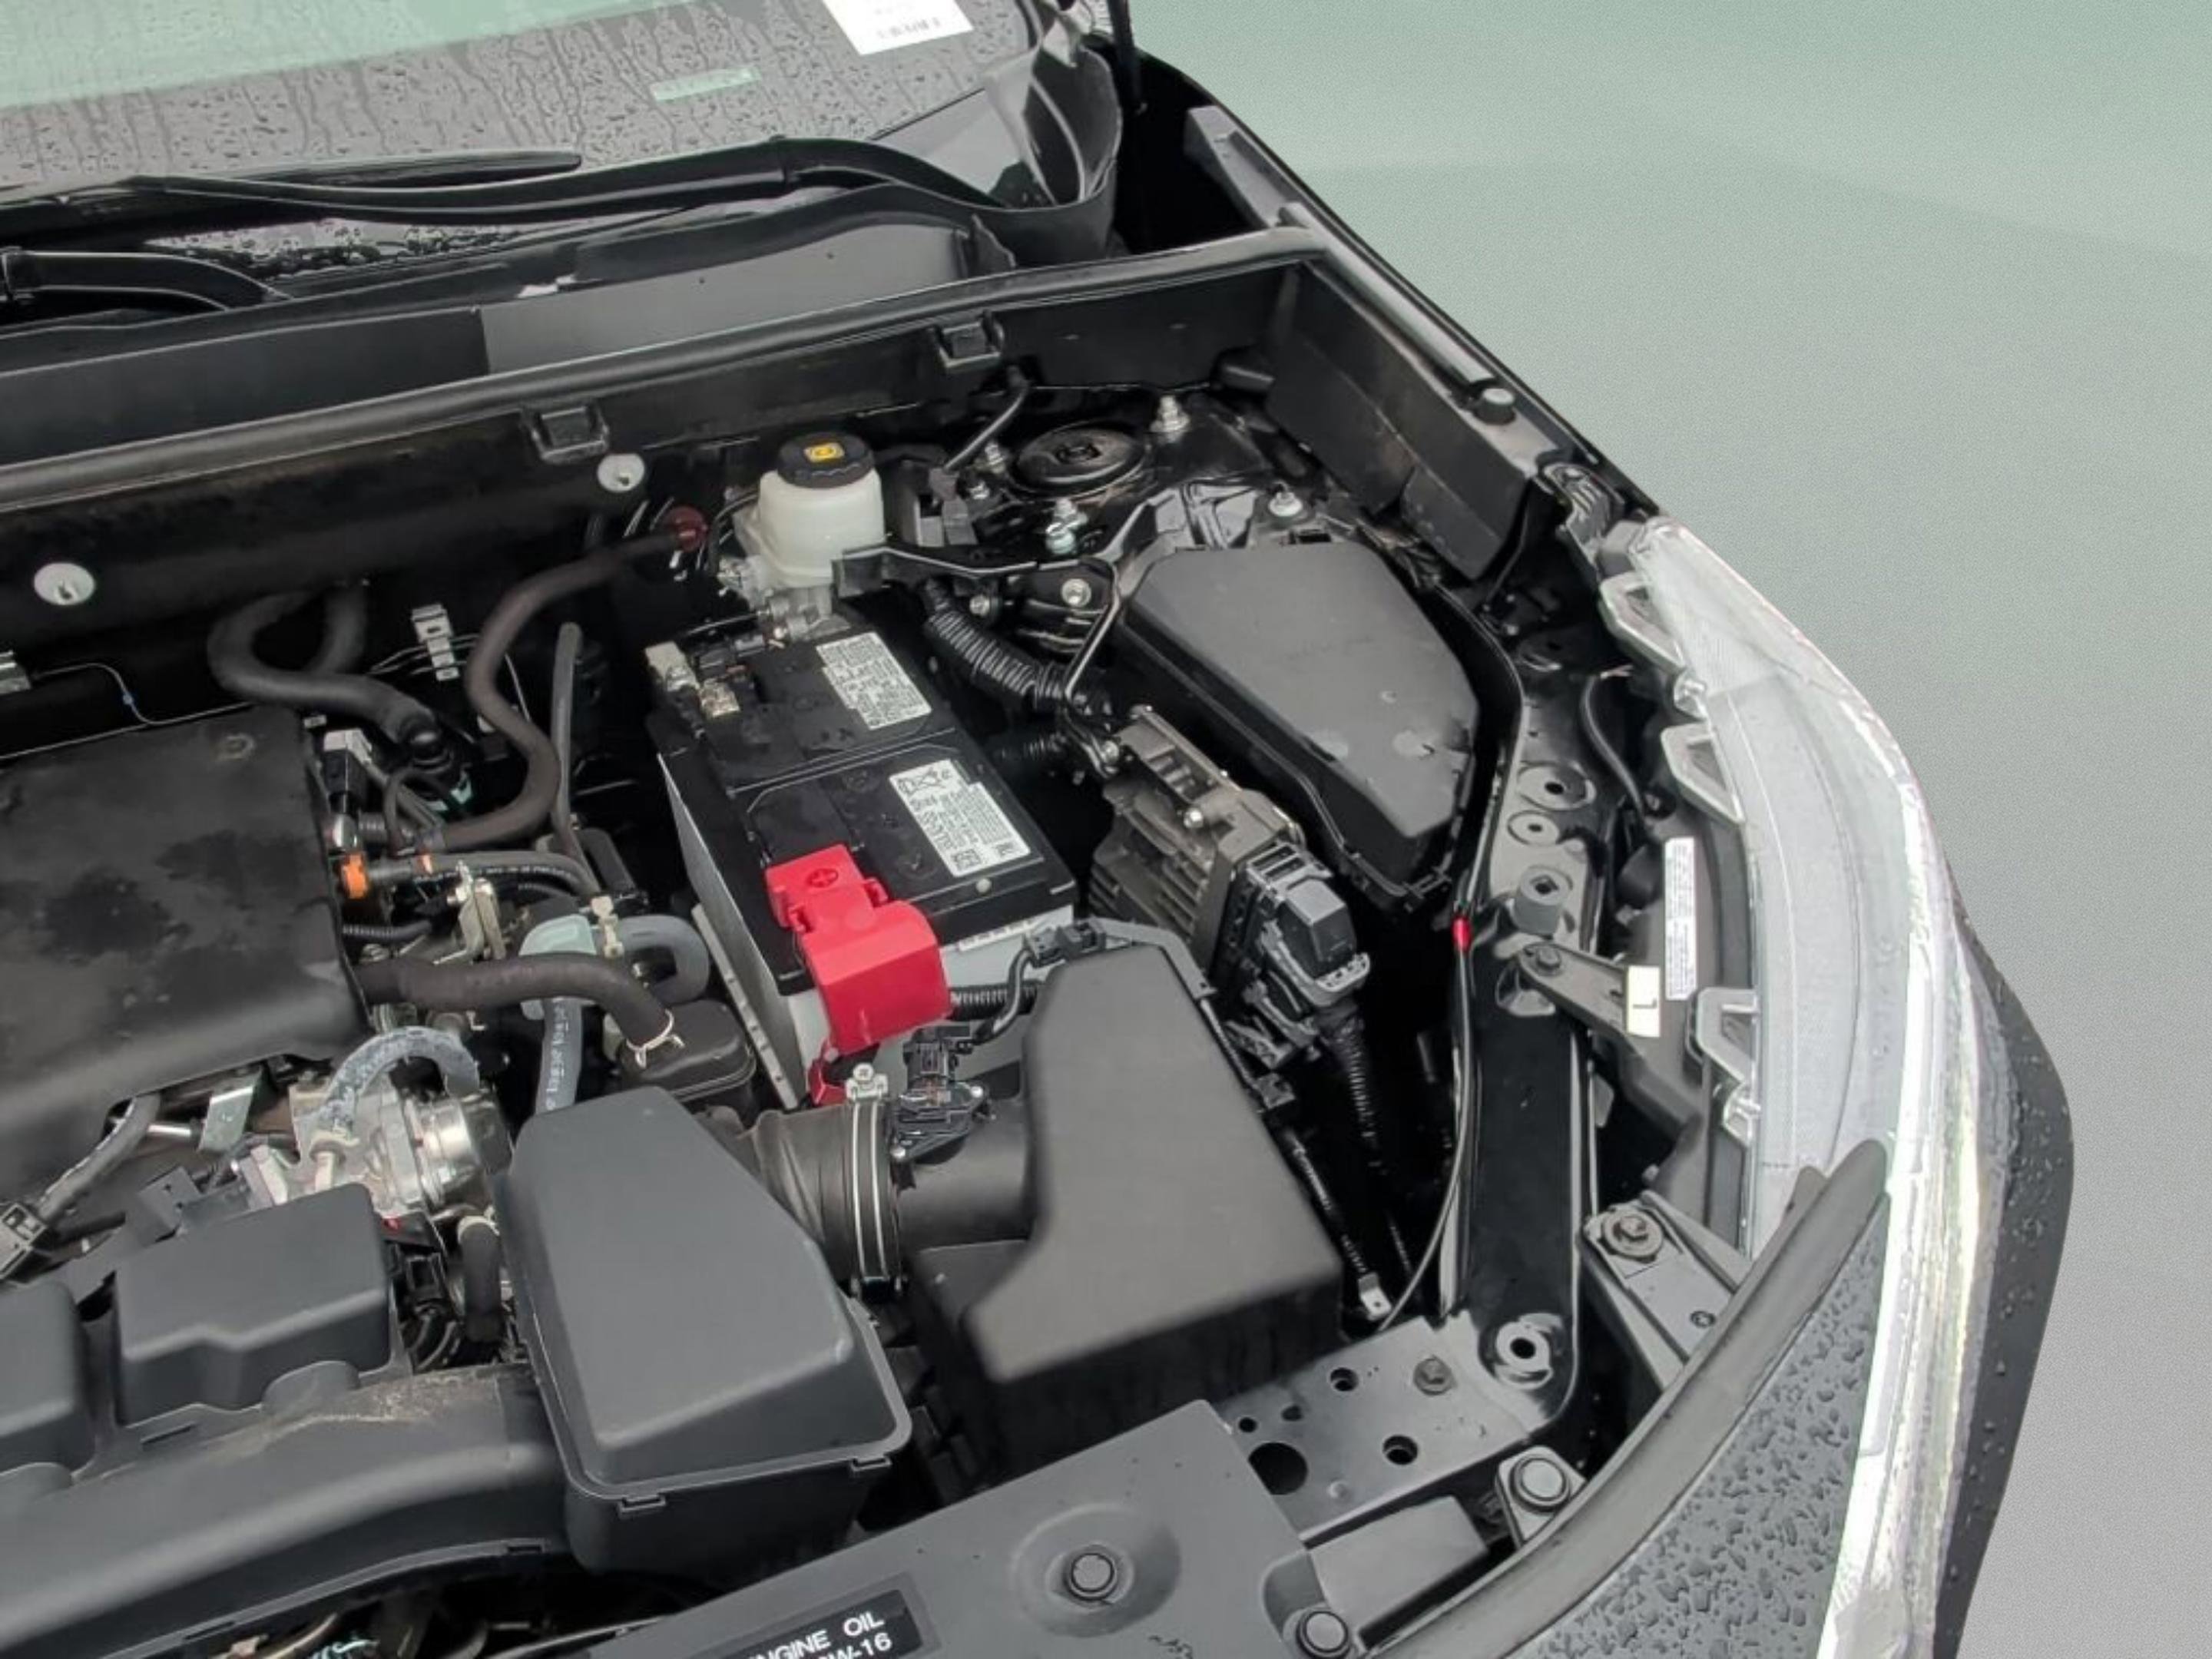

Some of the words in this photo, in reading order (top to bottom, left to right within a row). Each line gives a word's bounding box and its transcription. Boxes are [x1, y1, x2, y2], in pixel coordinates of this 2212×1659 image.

[749, 1628, 831, 1659] GINE
[843, 1611, 885, 1637] OIL
[818, 1632, 892, 1659] W-16
